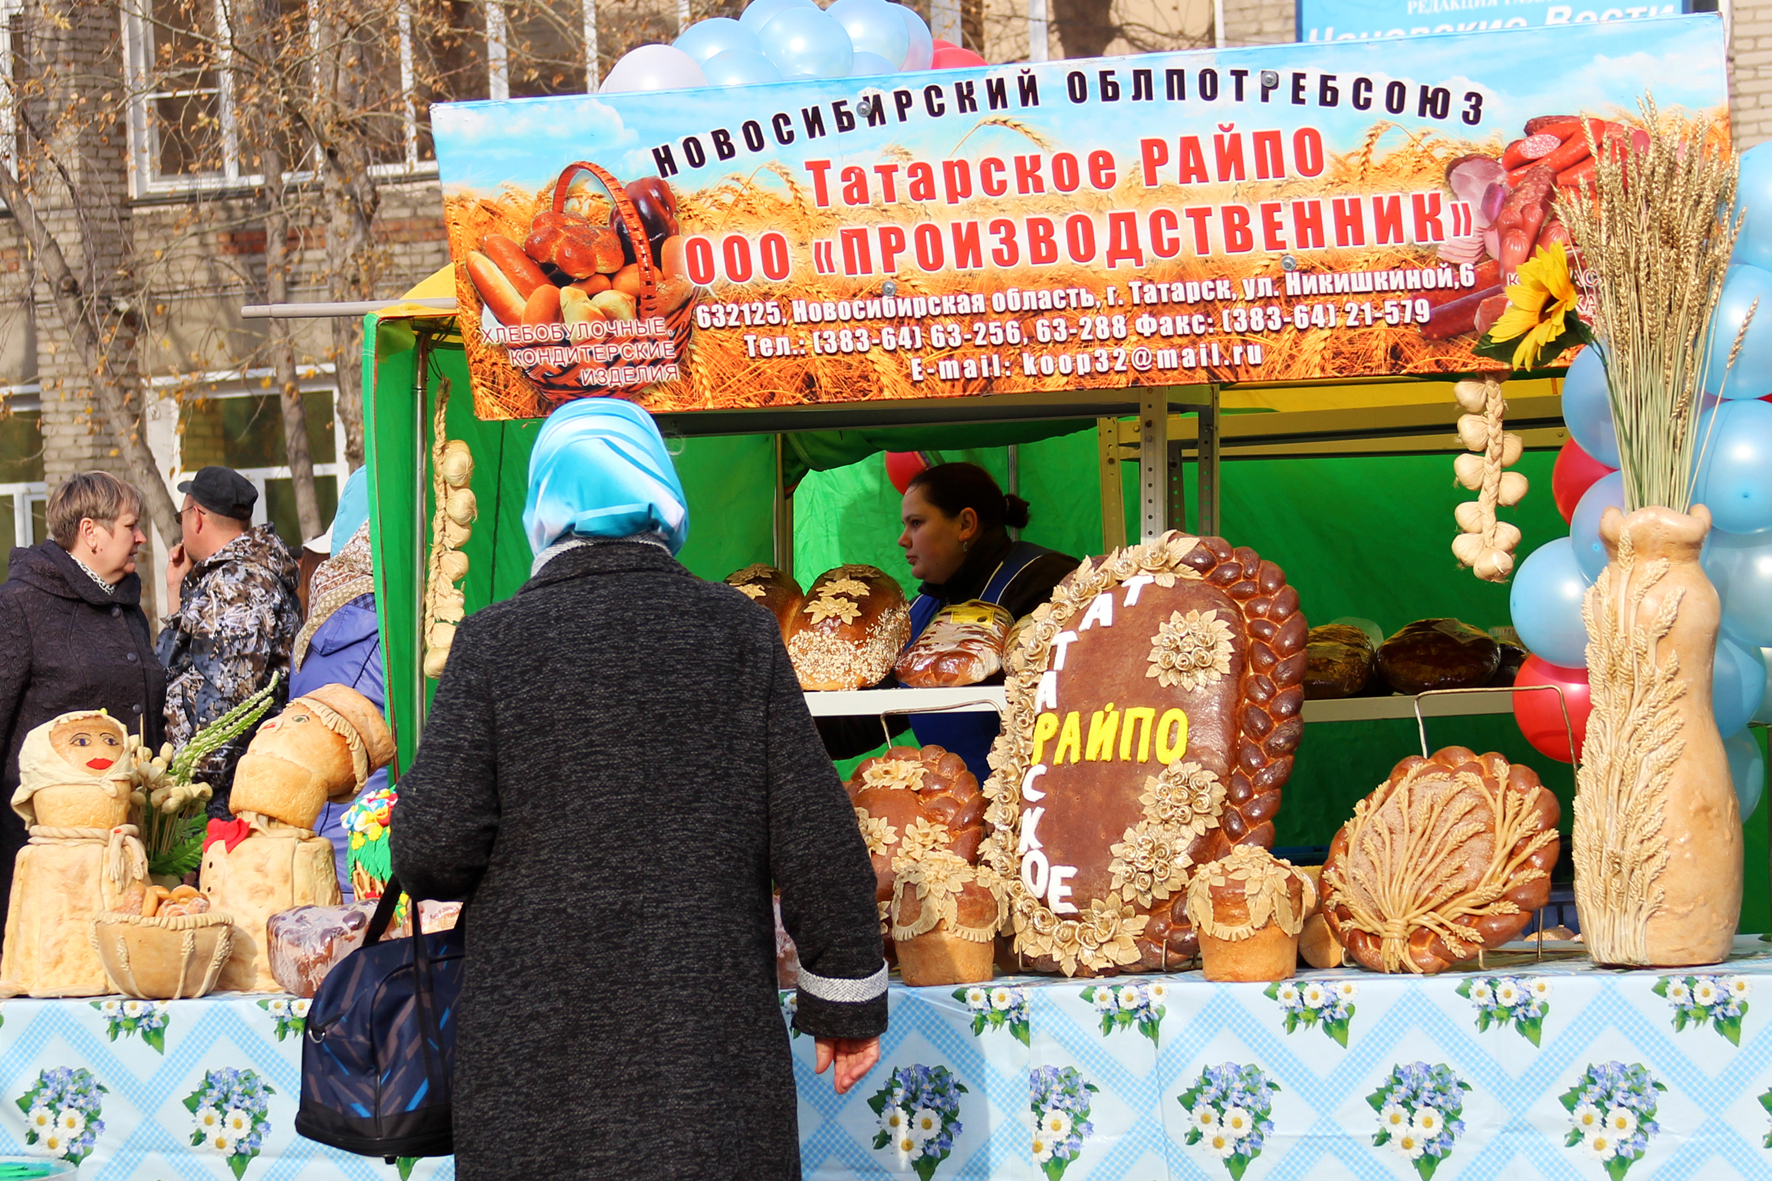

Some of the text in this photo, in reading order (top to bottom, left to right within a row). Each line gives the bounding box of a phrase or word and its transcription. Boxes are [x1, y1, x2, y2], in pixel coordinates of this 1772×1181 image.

[652, 68, 1484, 178] НОВОСИБИРСКИЙ ОБЛПОТРЕБСОЮЗ
[804, 123, 1325, 207] Татарское РАЙПО
[685, 192, 1474, 286] ООО «ПРОИЗВОДСТВЕННИК»
[696, 301, 787, 329] 632125,
[792, 293, 985, 323] Новосибирская
[992, 287, 1102, 312] область,
[1106, 286, 1124, 306] г.
[1128, 279, 1238, 304] Татарск,
[1242, 276, 1280, 301] ул.
[744, 298, 1431, 358] Тел.: (383-64) 63-256, 63-288 Факс: (383-64) 21-579
[481, 318, 674, 344] ХЛЕБОБУЛОЧНЫЕ,
[510, 341, 676, 366] КОНДИТЕРСКИЕ
[581, 364, 679, 386] ИЗДЕЛИЯ
[911, 342, 1263, 381] E-mail: koop32@mail.ru
[1031, 702, 1189, 765] РАЙПО
